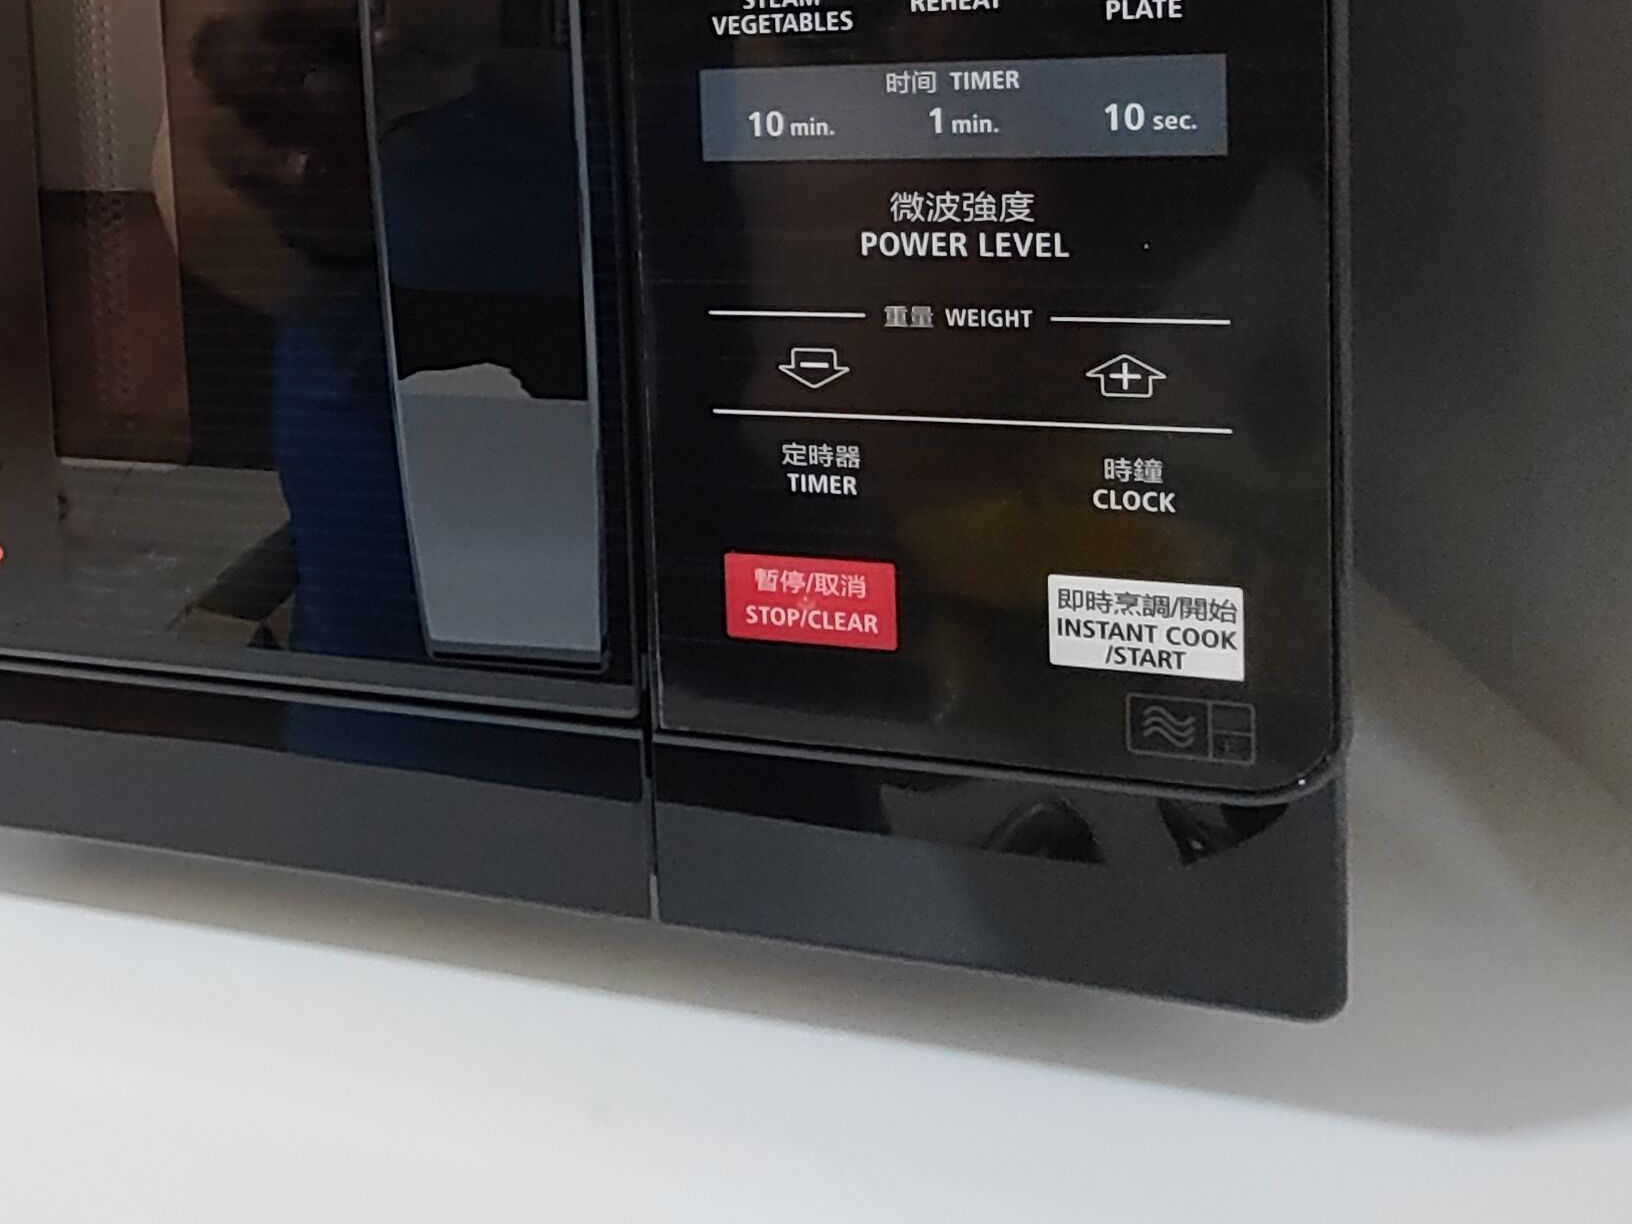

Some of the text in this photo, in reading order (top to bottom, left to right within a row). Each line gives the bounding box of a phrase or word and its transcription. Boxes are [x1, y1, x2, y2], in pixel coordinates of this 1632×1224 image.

[711, 10, 855, 36] VEGETABLES
[885, 70, 937, 94] 时间
[949, 69, 1020, 91] TIMER
[748, 110, 836, 138] 10 min.
[928, 107, 1000, 135] 1 min.
[1104, 102, 1198, 132] 10 sec.
[889, 190, 1036, 224] 微波強度
[860, 231, 1071, 258] POWER LEVEL
[944, 307, 1034, 329] WEIGHT
[781, 441, 861, 469] 定時器
[1103, 456, 1164, 484] 時鐘
[786, 472, 859, 496] TIMER
[1092, 488, 1177, 514] CLOCK
[745, 604, 879, 634] STOP/CLEAR
[1056, 617, 1238, 651] INSTANT COOK
[1105, 644, 1188, 671] /START
